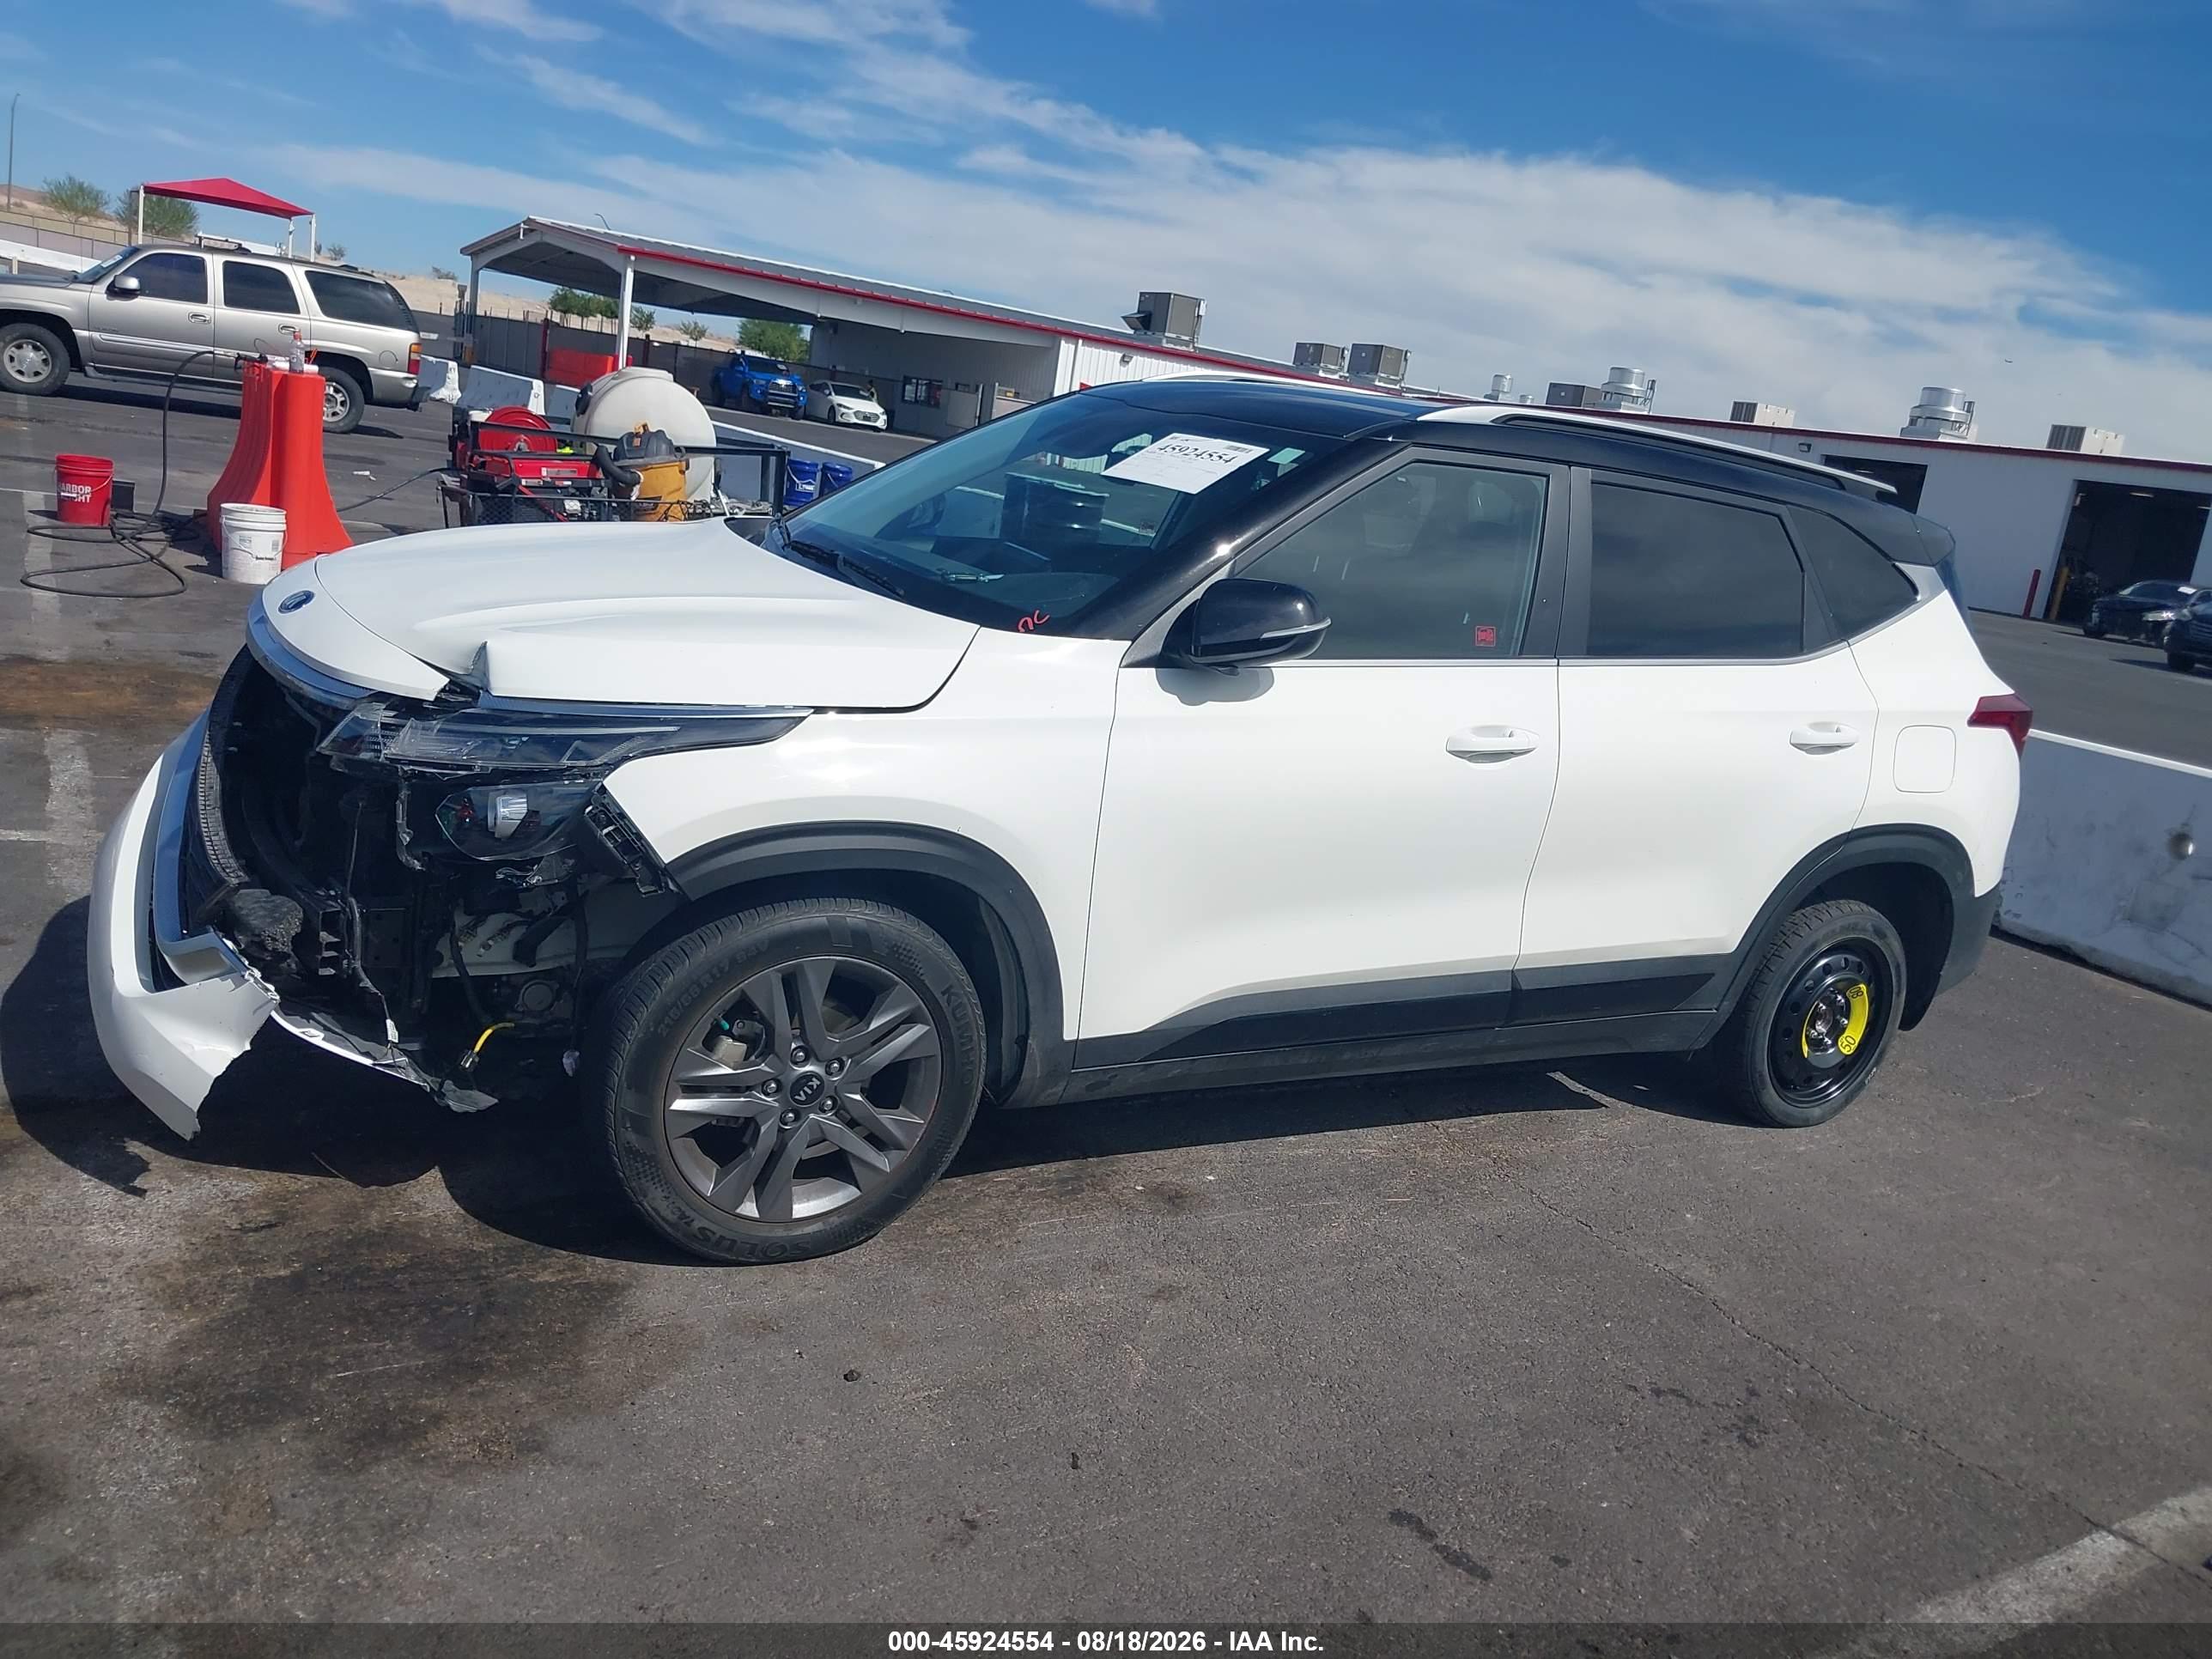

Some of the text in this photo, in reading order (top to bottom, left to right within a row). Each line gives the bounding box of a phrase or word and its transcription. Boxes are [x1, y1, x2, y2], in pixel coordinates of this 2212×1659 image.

[1157, 444, 1237, 465] 45924554
[1840, 1035, 1856, 1053] 50
[793, 1077, 821, 1101] KIA
[692, 1225, 811, 1259] SOLUS
